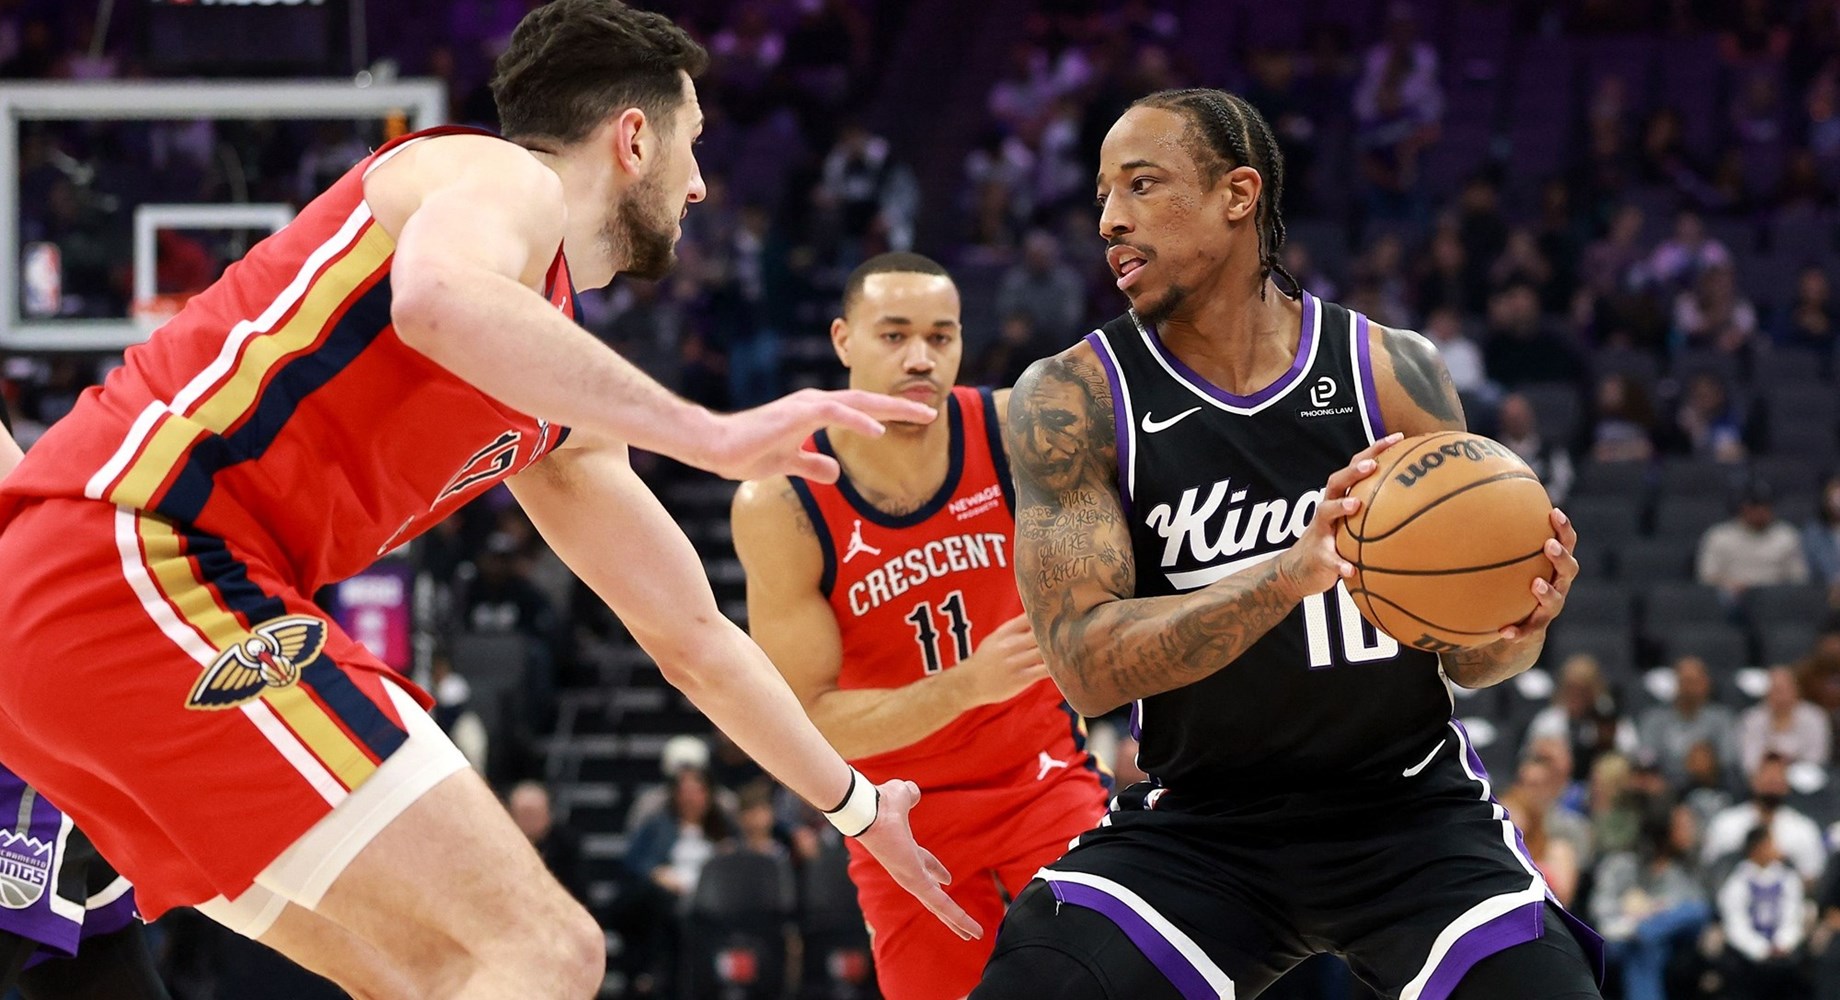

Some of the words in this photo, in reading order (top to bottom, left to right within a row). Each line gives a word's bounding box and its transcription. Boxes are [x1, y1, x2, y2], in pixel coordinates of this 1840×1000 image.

[1300, 408, 1335, 418] PHOONG
[1335, 406, 1354, 415] LAW
[948, 484, 1002, 515] NEWAGE
[848, 533, 1006, 617] CRESCENT
[904, 589, 973, 676] 11
[1303, 576, 1399, 670] 10
[0, 849, 48, 869] CRAMENTO
